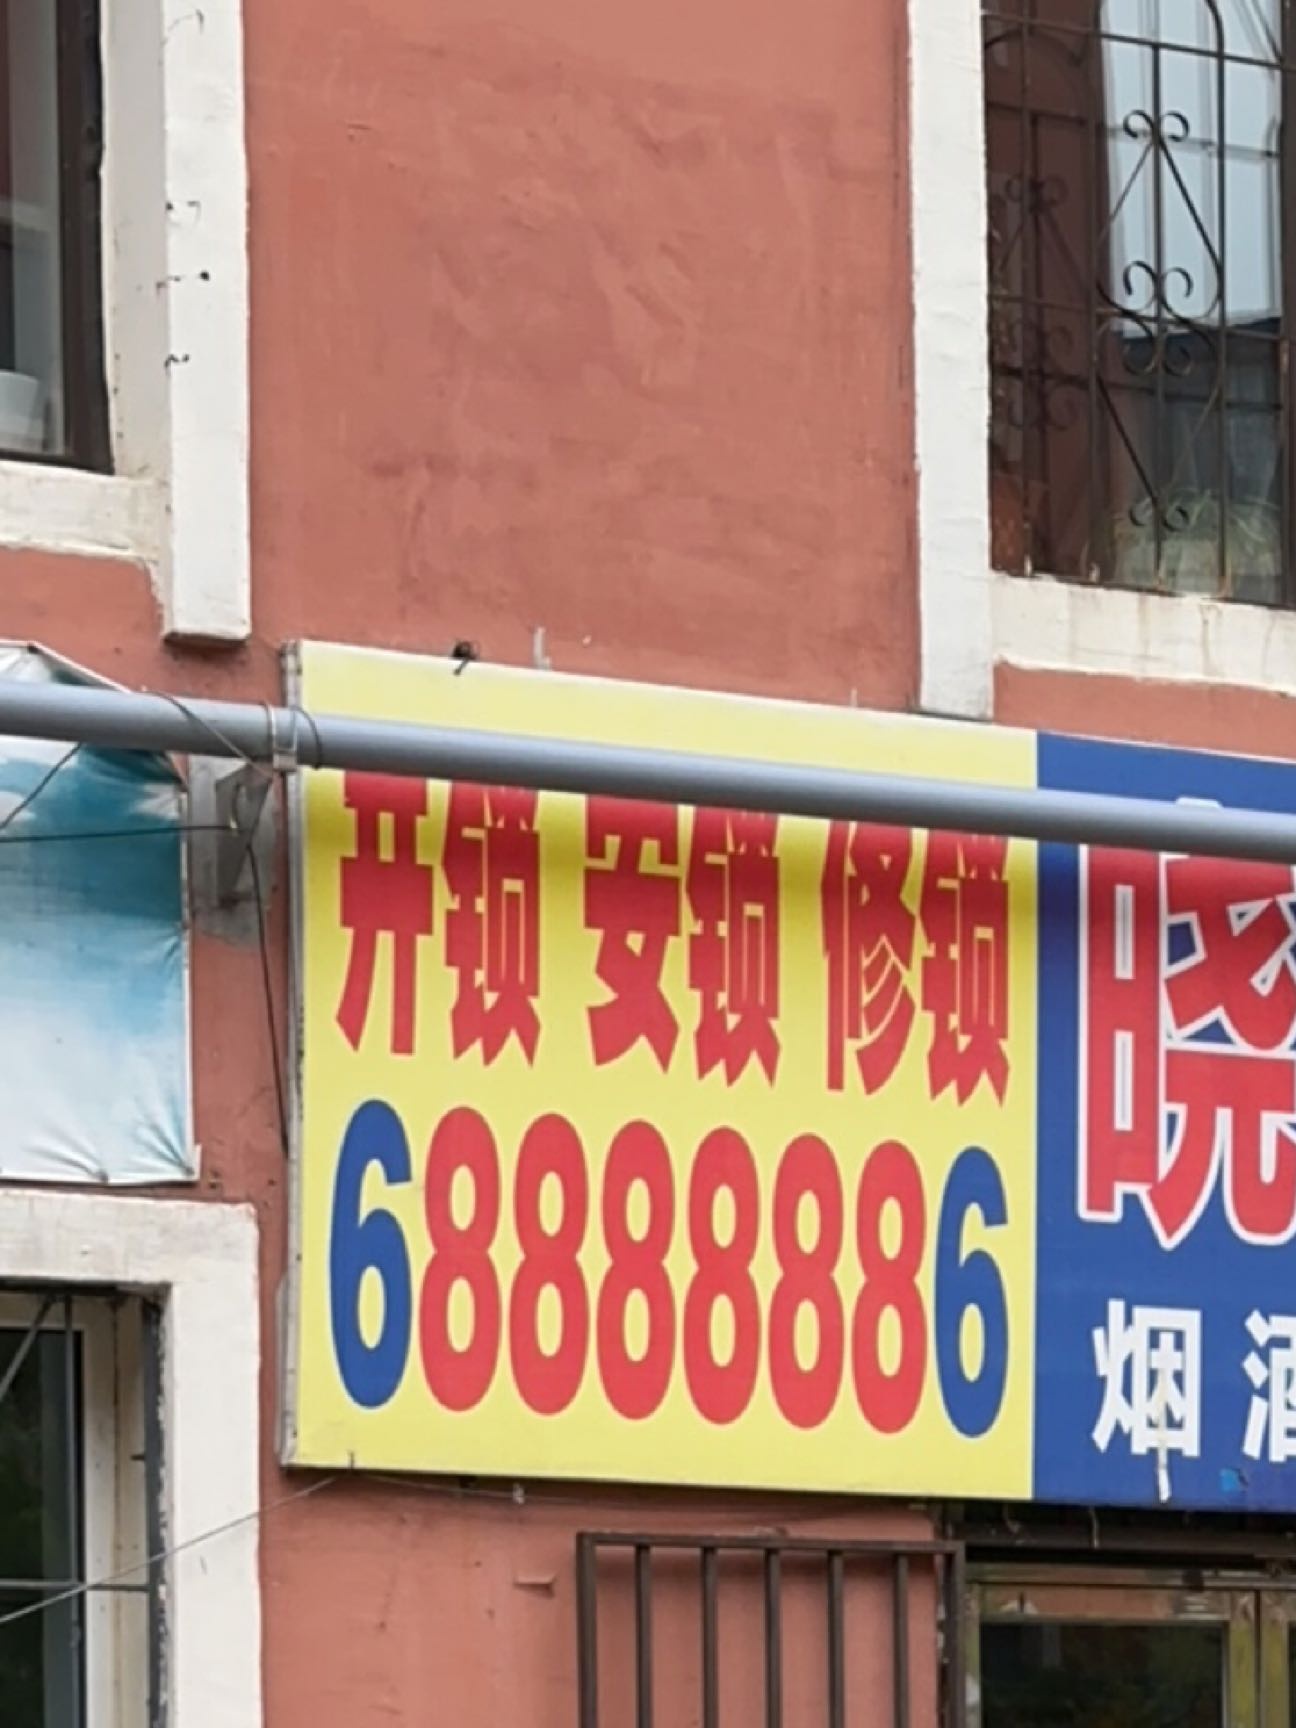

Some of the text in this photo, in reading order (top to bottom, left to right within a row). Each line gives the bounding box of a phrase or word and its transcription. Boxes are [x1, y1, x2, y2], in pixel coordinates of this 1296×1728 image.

[336, 771, 1009, 1107] 开锁 安锁 修锁
[330, 1099, 1008, 1438] 68888886
